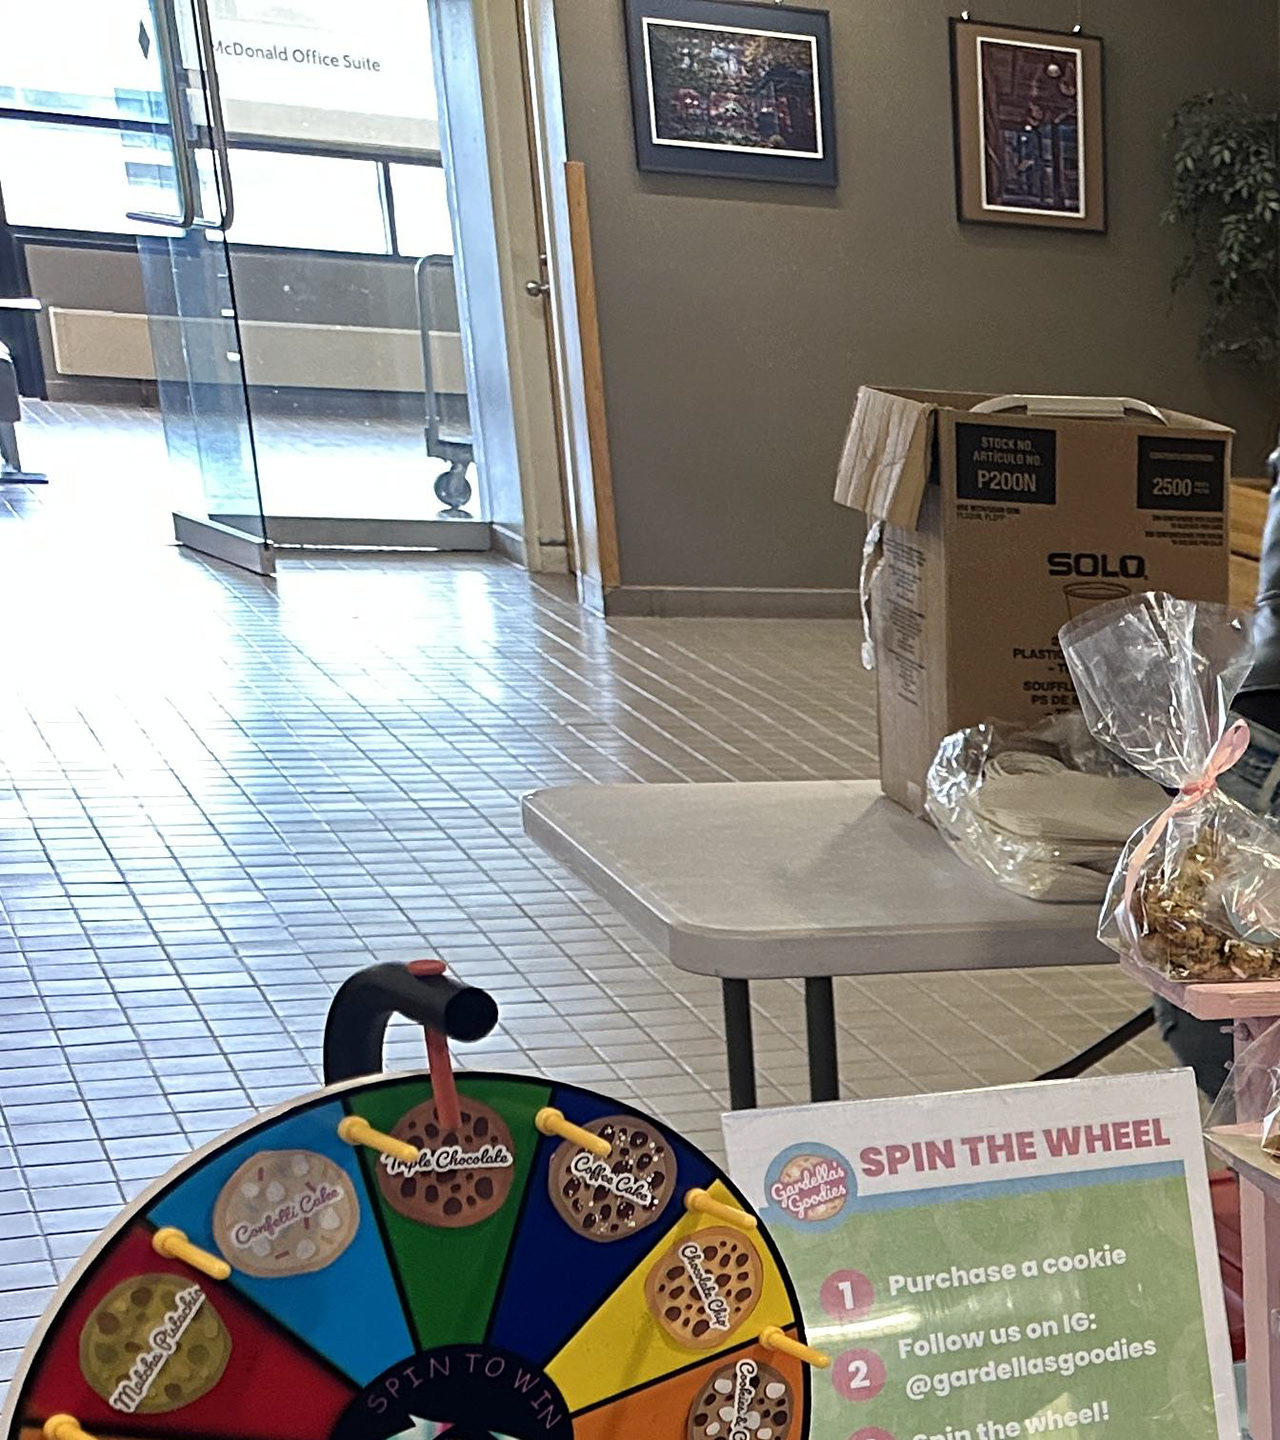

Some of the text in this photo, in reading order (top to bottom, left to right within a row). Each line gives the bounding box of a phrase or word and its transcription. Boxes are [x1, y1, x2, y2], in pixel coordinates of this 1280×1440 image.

[292, 48, 340, 68] Office
[342, 54, 381, 72] Suite
[981, 436, 1015, 450] STOCK
[977, 469, 1037, 493] P200N
[1152, 477, 1192, 497] 2500
[1047, 552, 1146, 579] SOLO
[1023, 681, 1076, 692] SOUFFL
[436, 1148, 509, 1170] Chocolate
[859, 1118, 1171, 1178] SPIN THE WHEEL
[574, 1155, 648, 1201] Coffee Cake
[771, 1161, 846, 1208] Gardella's
[235, 1186, 340, 1245] Confetti Cake
[788, 1184, 847, 1219] Goodies
[681, 1245, 728, 1328] Chocolate Chip
[889, 1243, 1128, 1297] Purchase a cookie
[837, 1280, 855, 1310] 1
[113, 1288, 204, 1410] Matcha Pistachio
[898, 1312, 1098, 1360] Follow us on IG:
[847, 1359, 871, 1390] 2
[905, 1336, 1158, 1401] @gardellasgoodies
[367, 1353, 563, 1430] SPIN TO WIN
[737, 1362, 755, 1414] Cookies
[733, 1415, 748, 1427] &
[1023, 1400, 1110, 1436] wheel!
